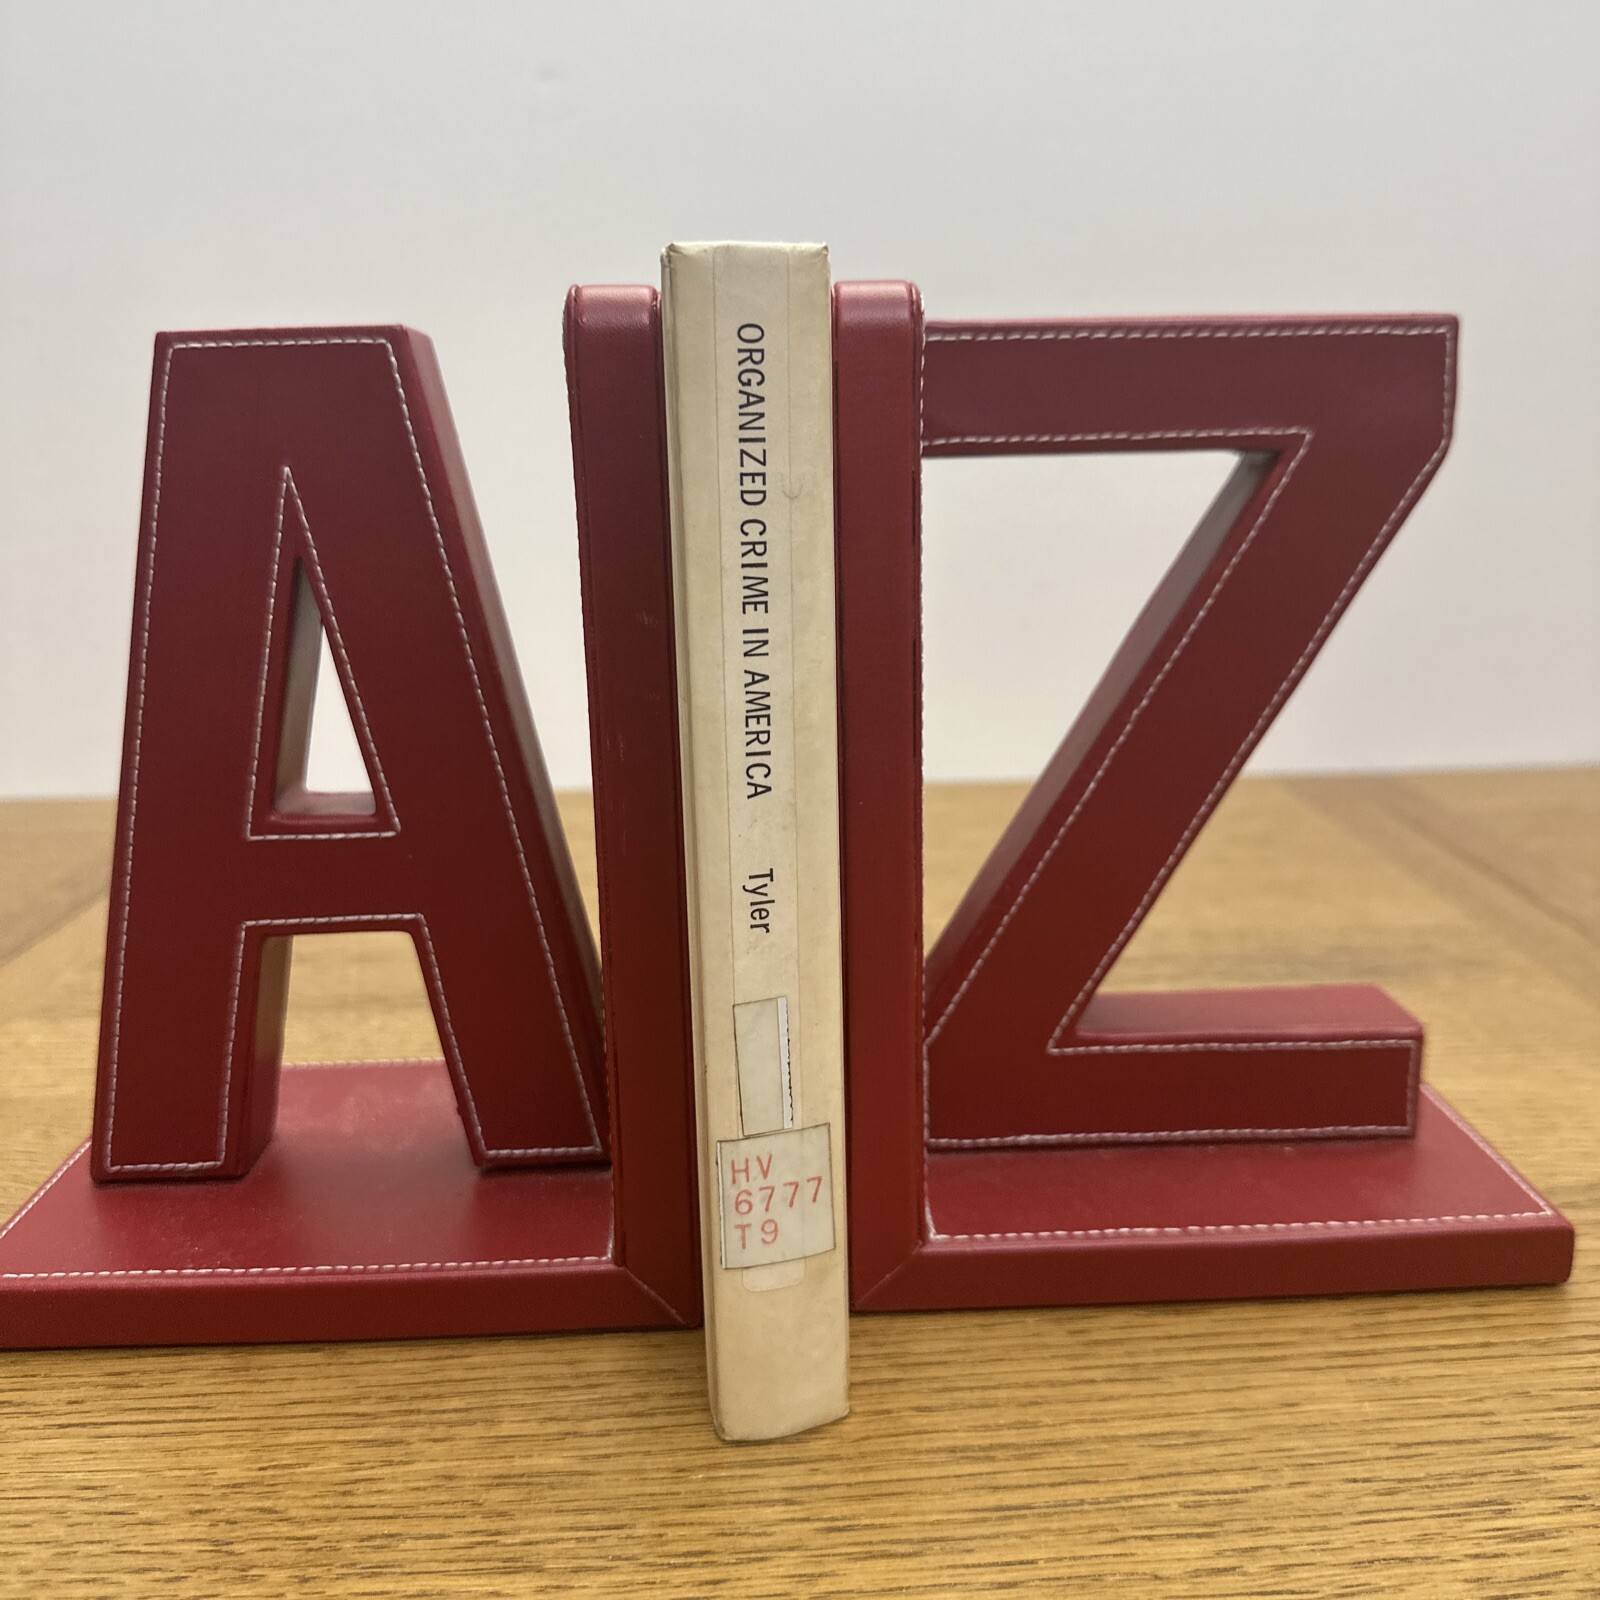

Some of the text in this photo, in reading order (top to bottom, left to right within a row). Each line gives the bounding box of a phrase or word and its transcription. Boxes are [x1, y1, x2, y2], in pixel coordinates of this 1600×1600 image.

[736, 322, 773, 800] ORGANIZED CRIME IN AMERICA
[91, 324, 610, 1183] A
[922, 311, 1461, 1153] Z
[742, 867, 776, 935] Tyler
[730, 1153, 773, 1186] HV
[734, 1175, 823, 1216] 6777
[734, 1218, 780, 1250] T9
